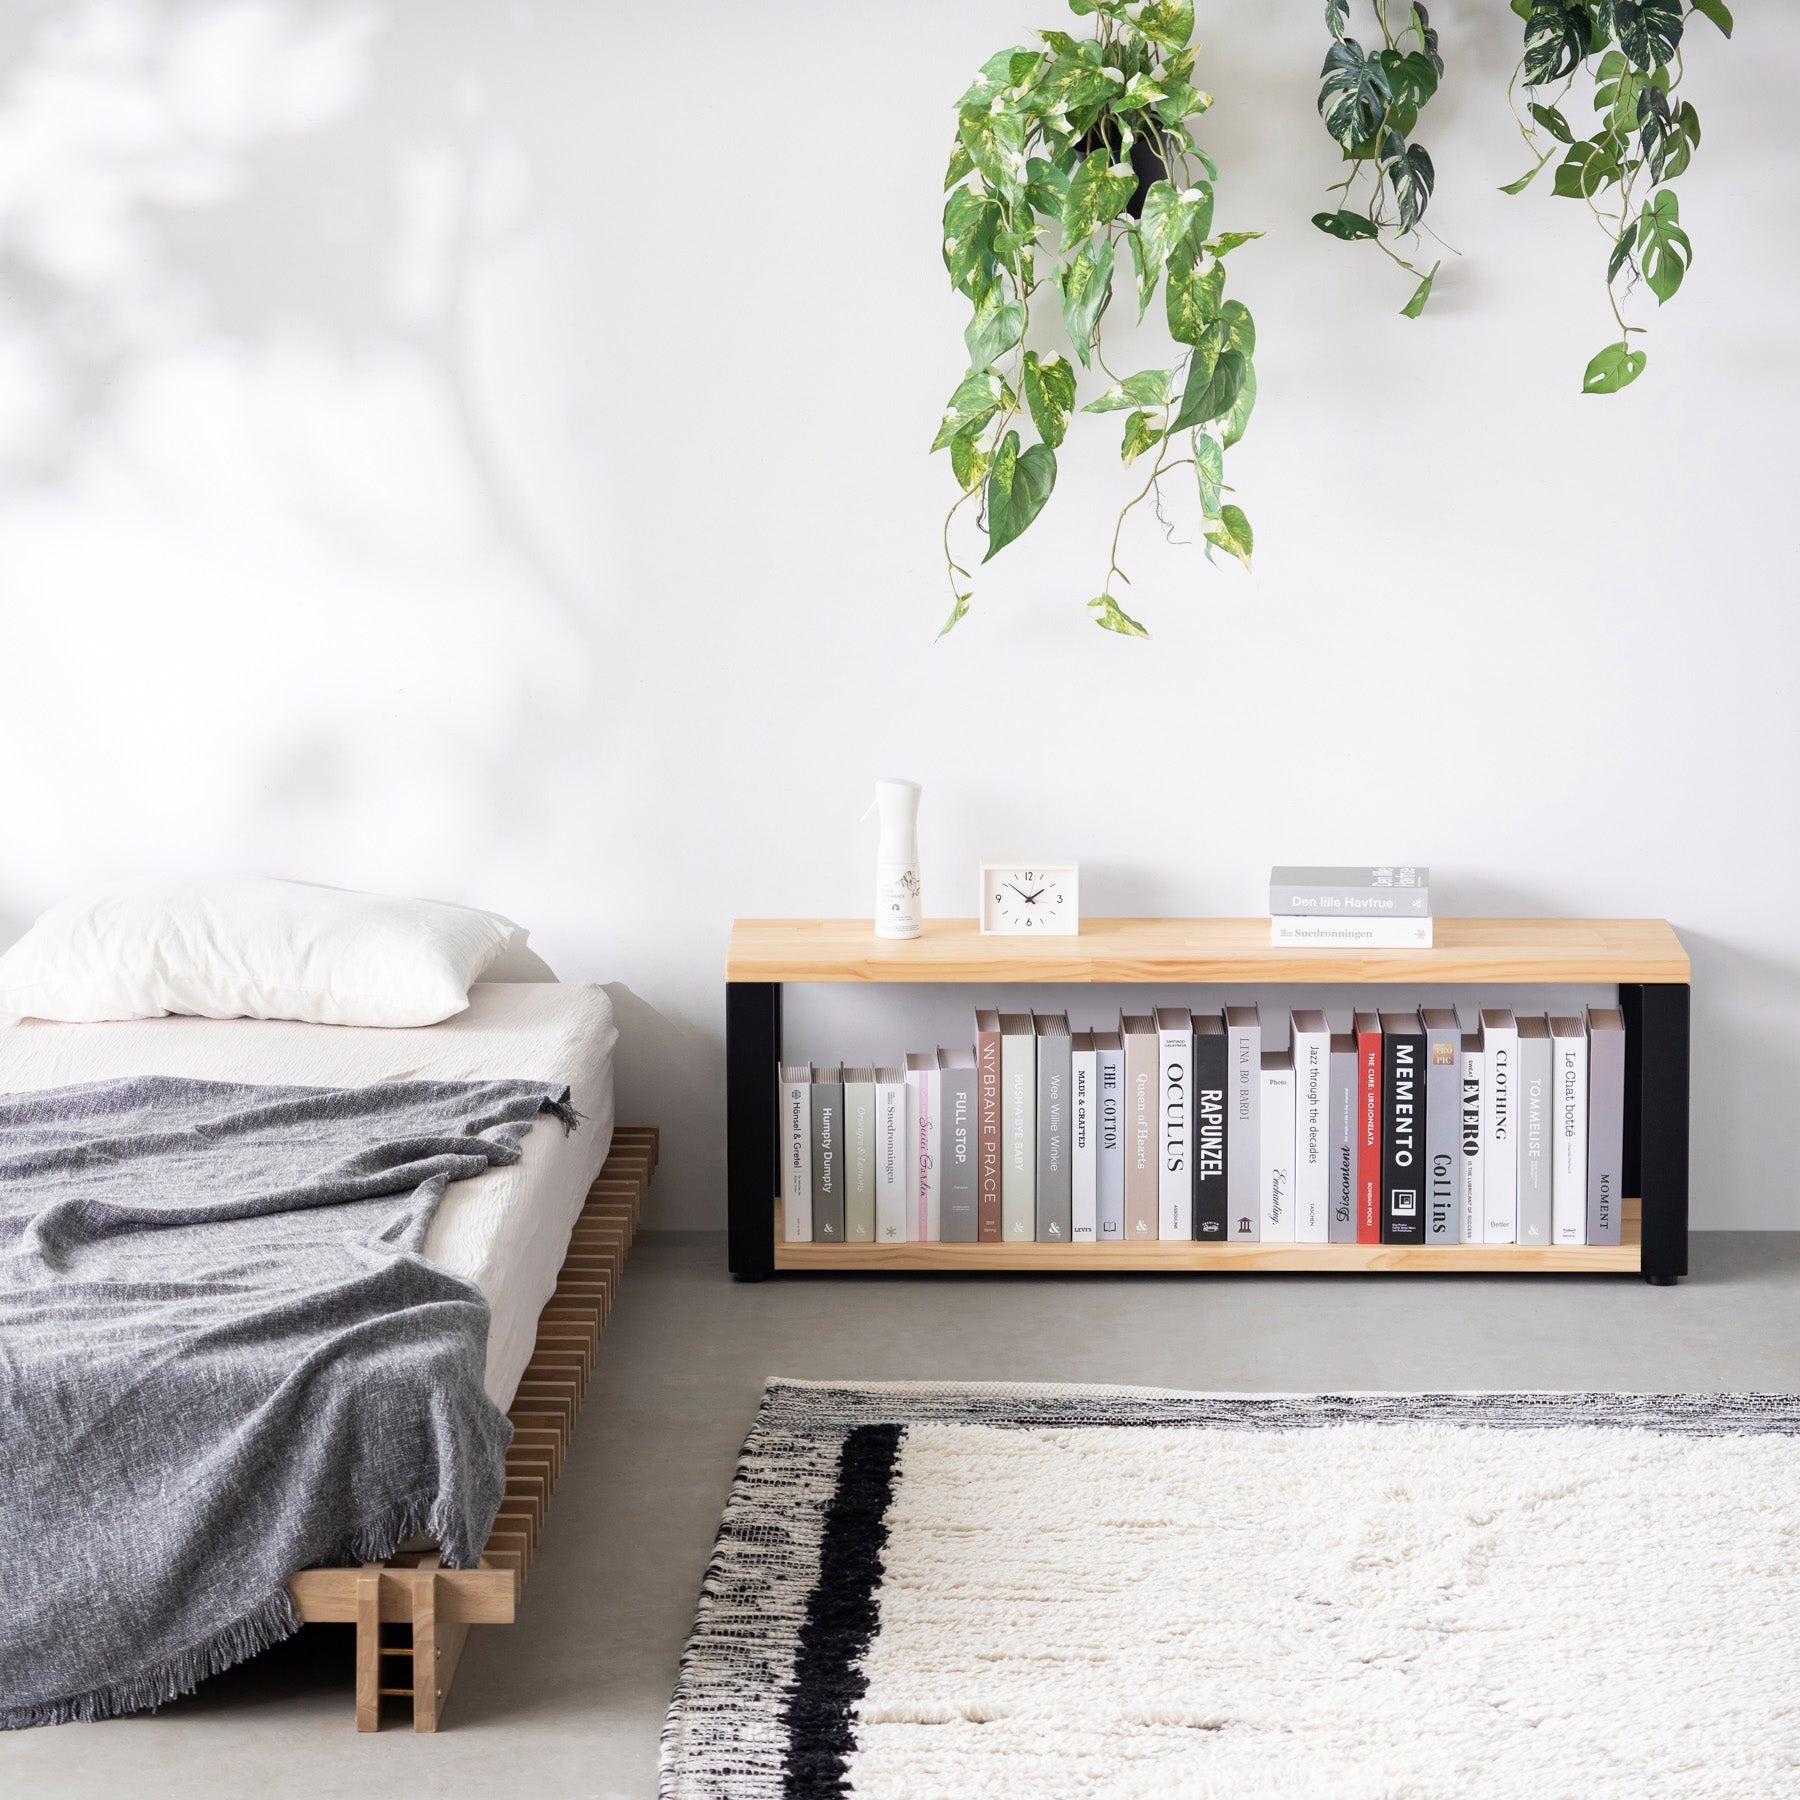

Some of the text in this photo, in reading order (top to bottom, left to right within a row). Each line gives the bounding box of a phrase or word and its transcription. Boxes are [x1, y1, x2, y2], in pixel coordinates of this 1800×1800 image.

[995, 895, 1002, 904] 9
[1024, 872, 1033, 881] 12
[1057, 895, 1064, 904] 3
[1292, 896, 1394, 909] Den lille Havfrue
[1026, 918, 1033, 927] 6
[1294, 928, 1373, 940] Snedronningen
[1239, 1038, 1250, 1121] LINA BO BARDI
[1436, 1056, 1452, 1064] PIC
[1565, 1052, 1576, 1068] Le
[1565, 1070, 1576, 1101] Chat
[793, 1102, 802, 1134] Hänsel
[855, 1106, 866, 1145] Oranges
[955, 1091, 967, 1165] FULL STOP.
[983, 1041, 996, 1203] WYBRANE PRACE
[1013, 1073, 1024, 1172] HUSH-A-BYE BABY
[1050, 1074, 1061, 1172] Wee Willie Winkie
[1078, 1070, 1086, 1149] MADE & CRAFTED
[1103, 1063, 1117, 1151] THE COTTON
[1136, 1073, 1149, 1170] Queen of Hearts
[1166, 1063, 1185, 1172] OCULUS
[1307, 1046, 1320, 1164] Jazz through the decades
[1367, 1092, 1375, 1146] UROJONELATA
[1394, 1044, 1414, 1167] MEMENTO
[1462, 1079, 1480, 1157] EVERO
[1495, 1049, 1508, 1141] CLOTHING
[1528, 1078, 1542, 1157] TOMMELISE
[1565, 1103, 1576, 1137] botté
[793, 1142, 802, 1169] Gretel
[821, 1107, 833, 1193] Humpty Dumpty
[885, 1106, 897, 1184] Snedronningen
[1200, 1089, 1223, 1181] RAPUNZEL
[856, 1157, 865, 1193] Lemons
[919, 1152, 933, 1197] Garden
[1268, 1168, 1288, 1226] Enchanting.
[1336, 1144, 1351, 1222] Discontent
[1432, 1154, 1453, 1233] Collins
[1599, 1173, 1610, 1230] MOMENT
[1490, 1220, 1510, 1228] Better
